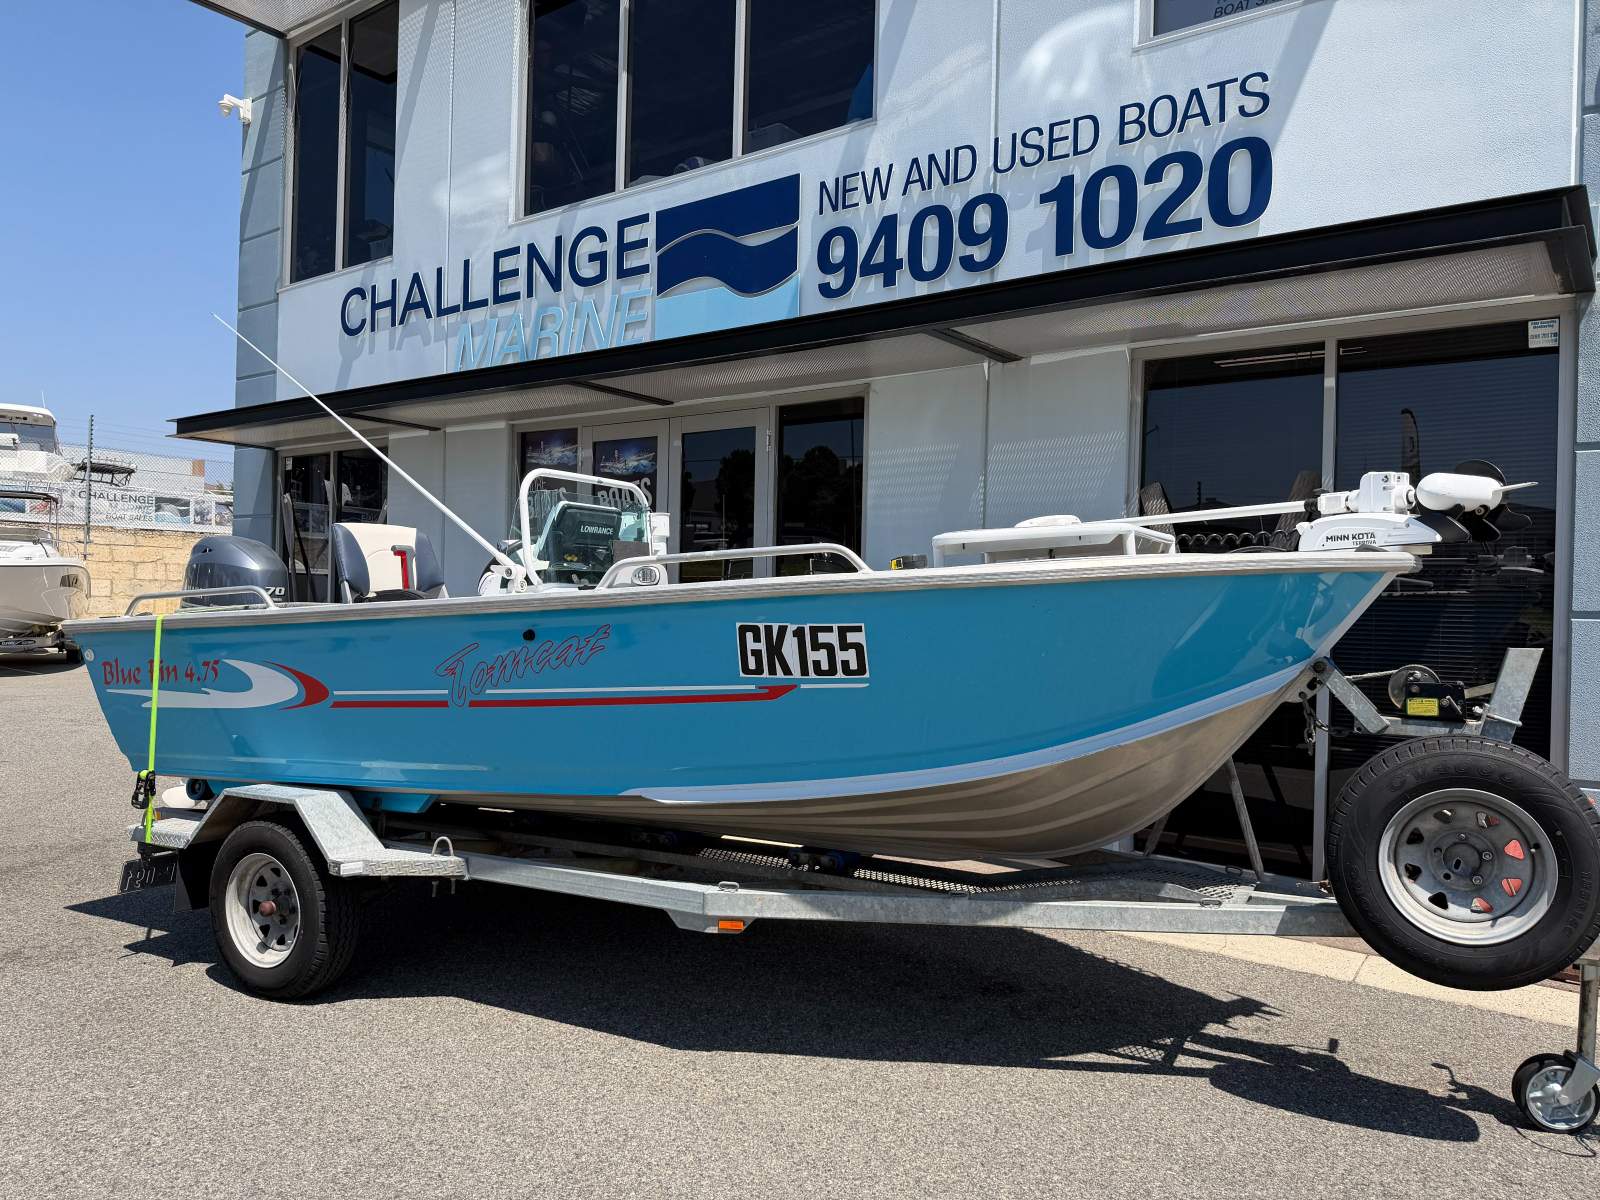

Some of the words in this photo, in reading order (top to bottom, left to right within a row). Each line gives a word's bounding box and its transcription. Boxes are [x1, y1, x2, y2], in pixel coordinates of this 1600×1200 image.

[1214, 0, 1250, 18] BOAT
[818, 163, 894, 215] NEW
[902, 144, 978, 196] AND
[993, 114, 1100, 175] USED
[1118, 72, 1270, 146] BOATS
[816, 192, 1009, 299] 9409
[1039, 136, 1273, 257] 1020
[340, 212, 651, 337] CHALLENGE
[454, 287, 654, 373] MARINE
[78, 490, 154, 505] CHALLENGE
[580, 525, 614, 535] LOWRANCE
[1325, 533, 1350, 542] MINN
[1352, 532, 1376, 540] KOTA
[265, 586, 286, 597] 70
[102, 656, 142, 685] Blue
[185, 659, 220, 682] 4.75
[434, 623, 612, 707] Tomcat
[737, 623, 869, 678] GK155
